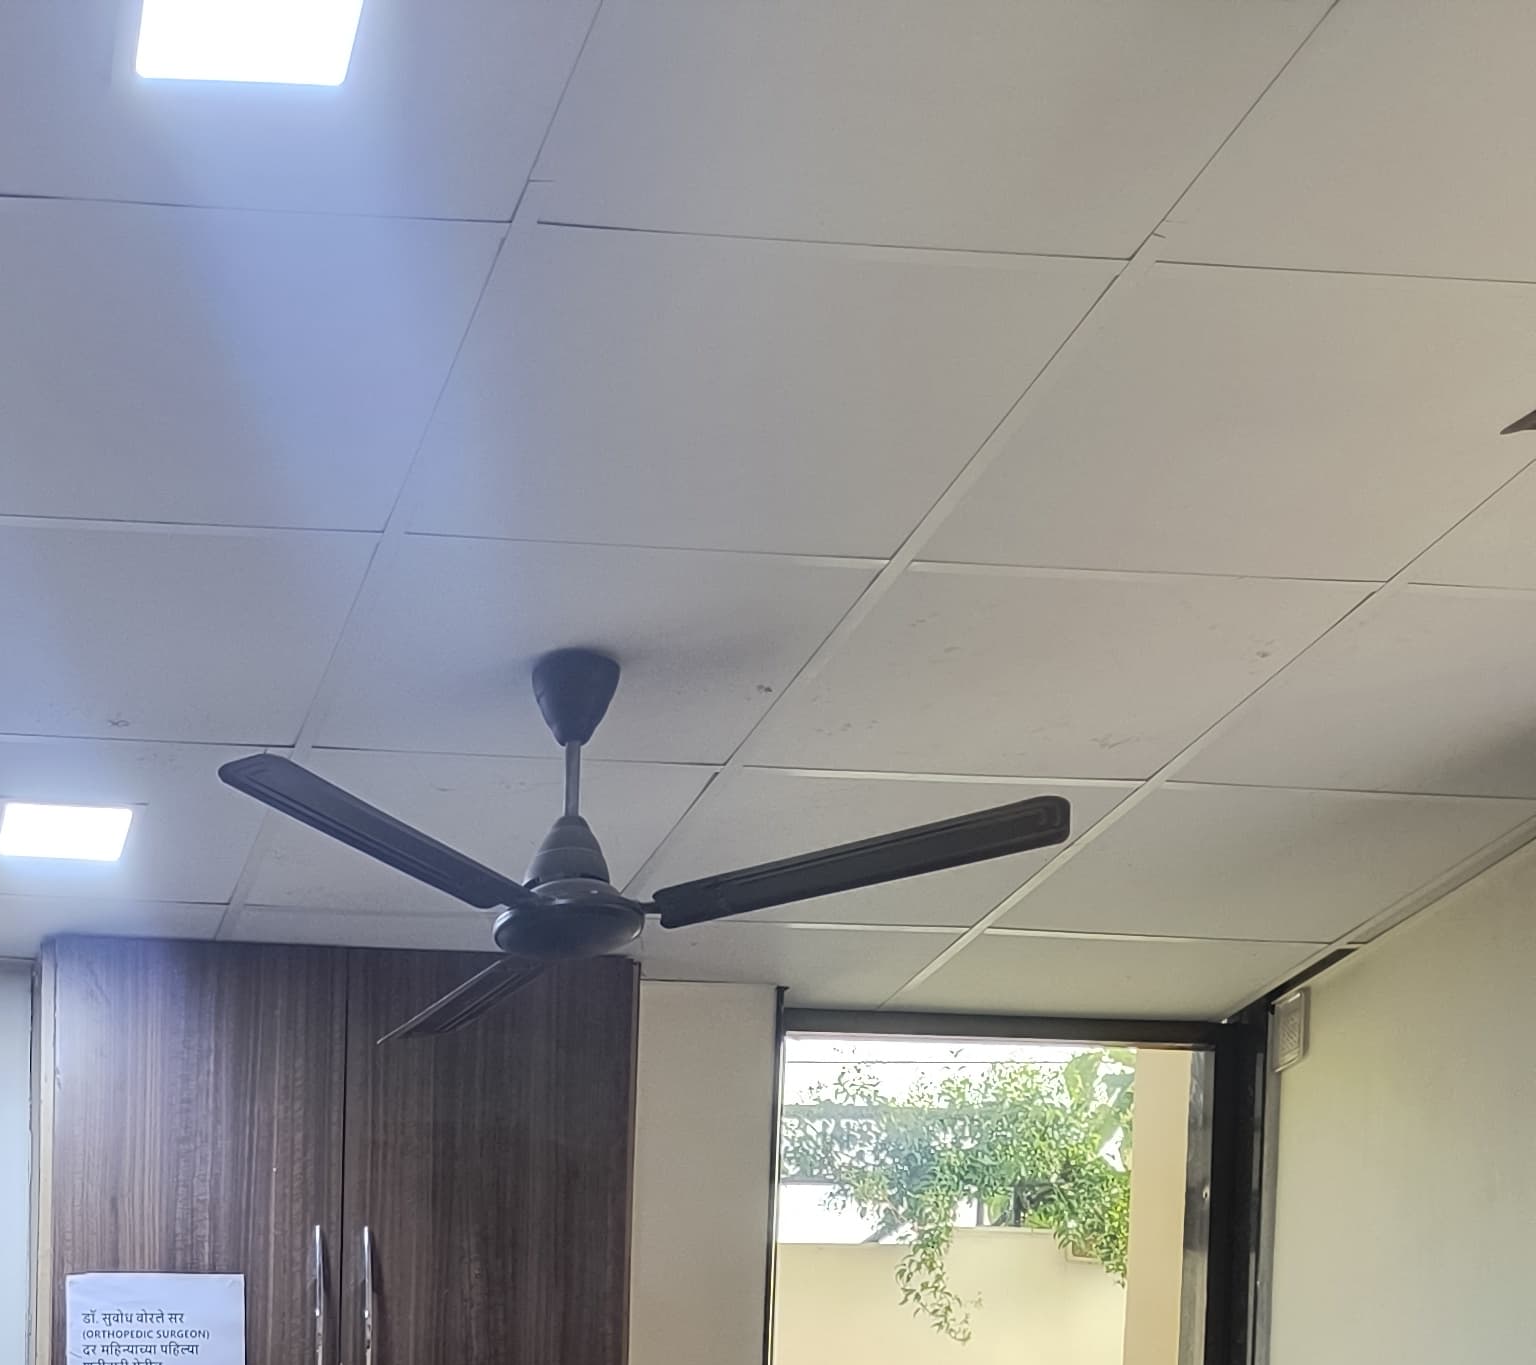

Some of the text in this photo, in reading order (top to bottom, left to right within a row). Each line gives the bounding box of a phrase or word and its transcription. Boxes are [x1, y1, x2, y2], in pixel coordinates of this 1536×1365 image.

[168, 1311, 185, 1324] सर
[82, 1329, 210, 1340] (ORTHOPEDIC SURGEON)
[82, 1341, 199, 1357] दर महिन्याच्या पहिल्या
